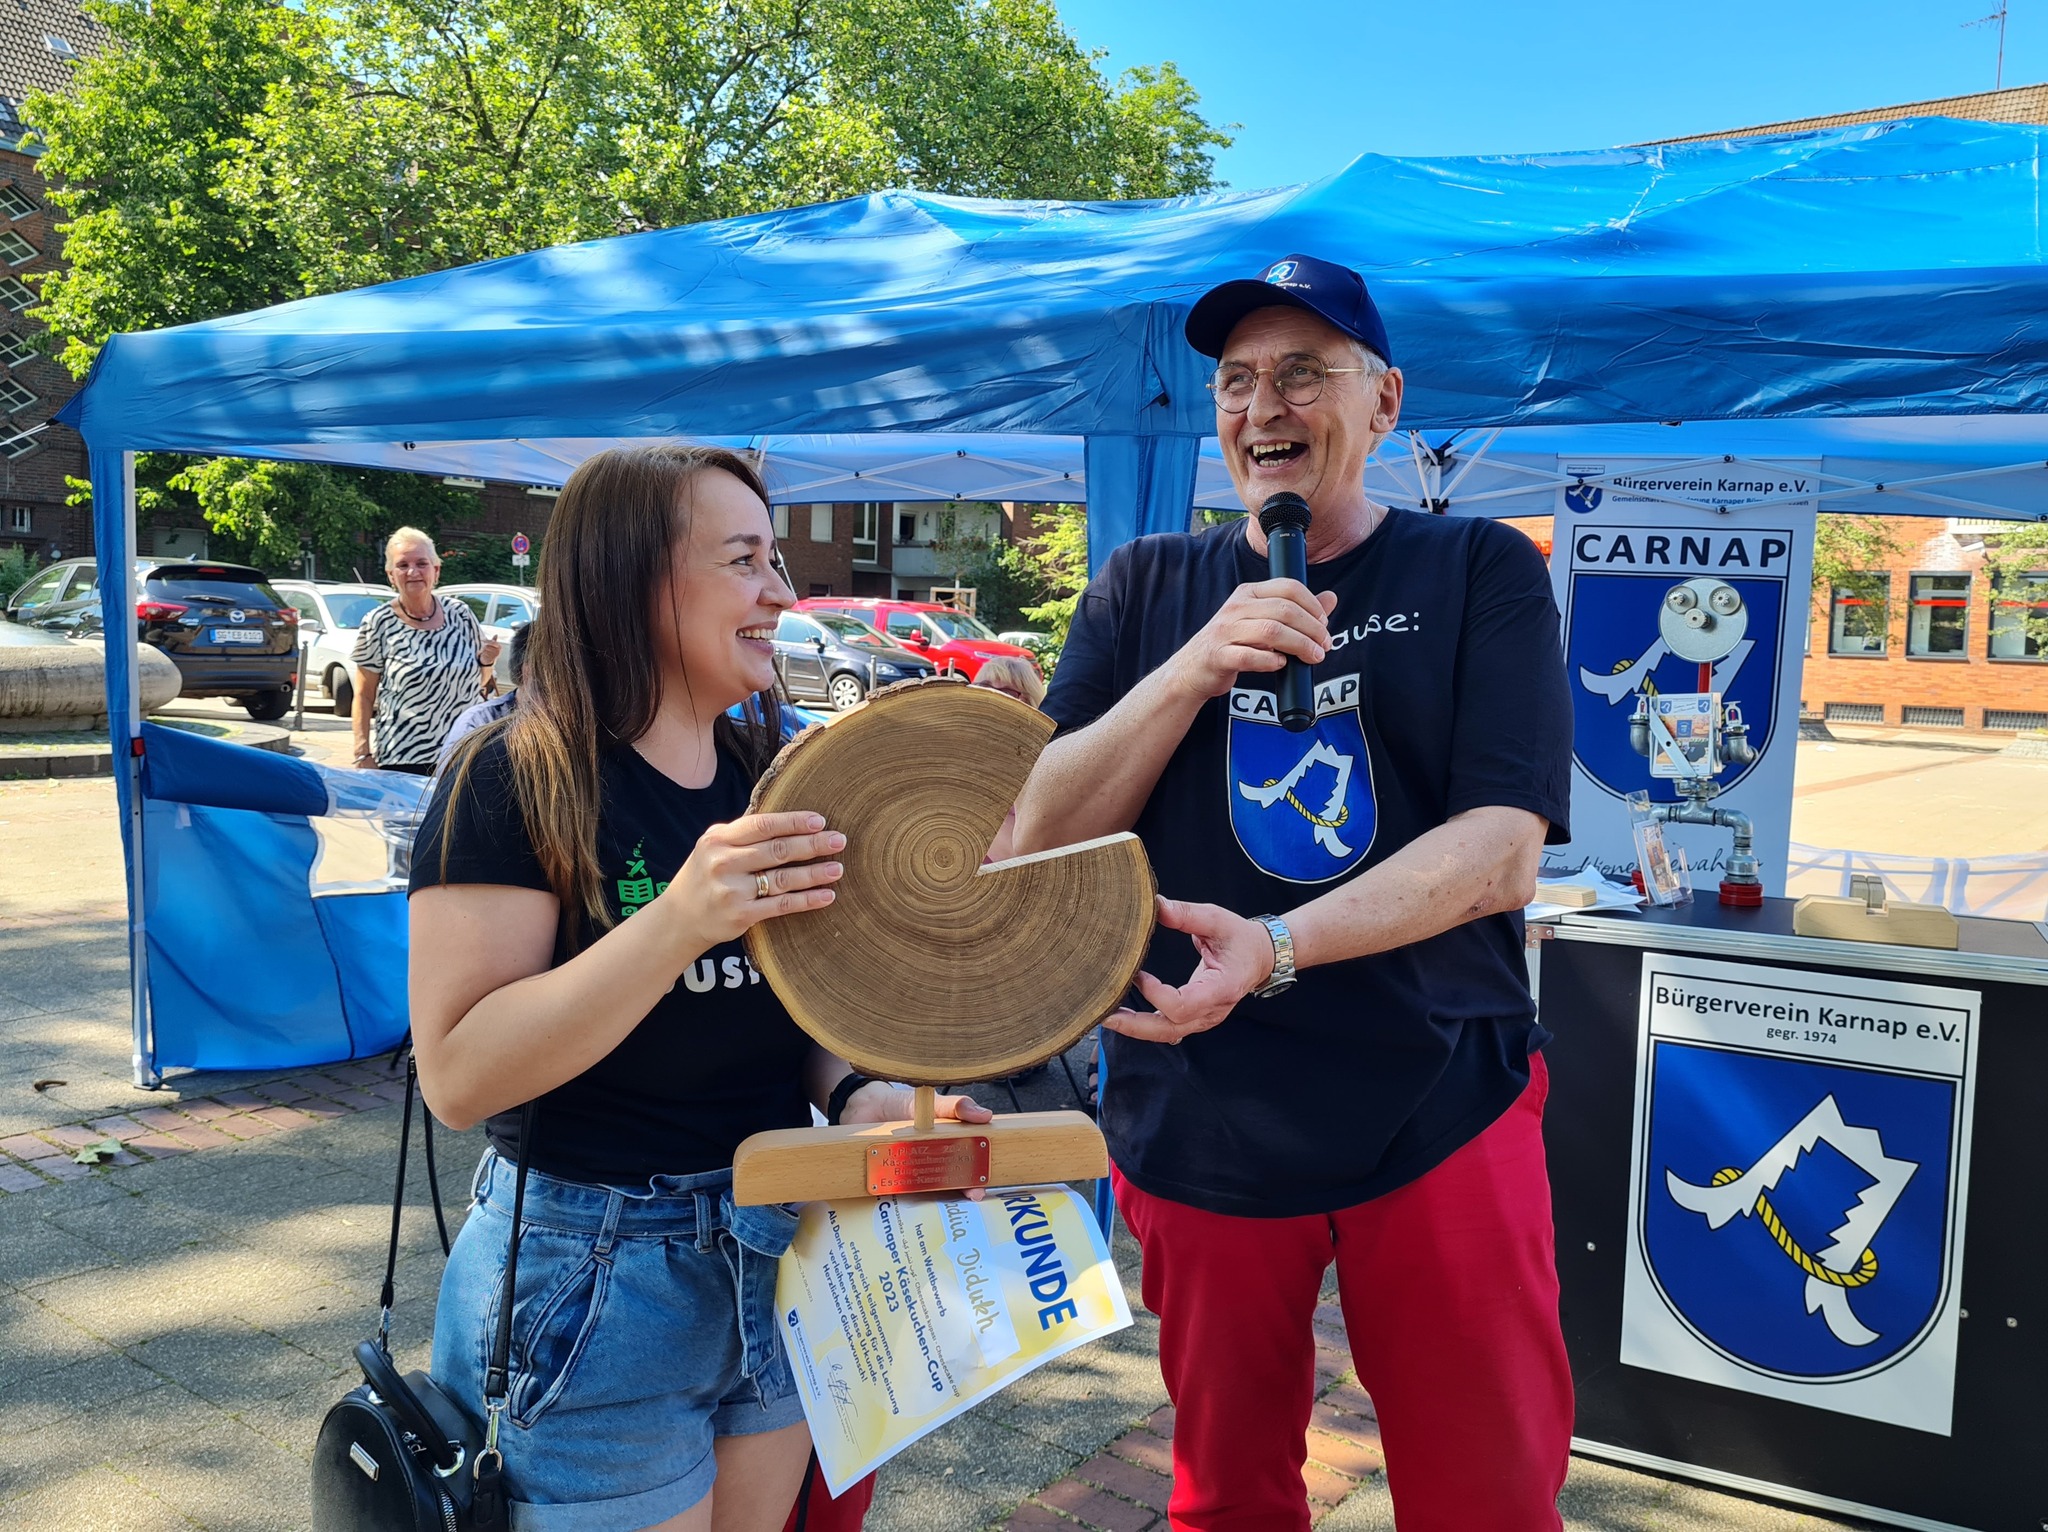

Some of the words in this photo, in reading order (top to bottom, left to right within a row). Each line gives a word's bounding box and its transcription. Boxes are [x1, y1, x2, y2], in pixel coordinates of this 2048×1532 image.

[1718, 478, 1774, 494] Karnap
[1778, 479, 1810, 493] e.V.
[1576, 534, 1787, 568] CARNAP
[1230, 679, 1357, 717] CAAP
[1656, 986, 1810, 1023] Bürgerverein
[1818, 1007, 1908, 1039] Karnap
[1916, 1021, 1961, 1043] e.V.
[1766, 1026, 1799, 1040] gegr.
[1804, 1030, 1837, 1045] 1974
[828, 1210, 837, 1224] Als
[915, 1223, 925, 1239] hat
[944, 1199, 967, 1242] adiia
[832, 1224, 845, 1250] Dank
[919, 1241, 927, 1256] am
[840, 1251, 852, 1270] und
[847, 1272, 872, 1337] Anerkennung
[850, 1241, 870, 1292] erfolgreich
[866, 1293, 893, 1366] teilgenommen.
[876, 1201, 902, 1264] Carnaper
[899, 1266, 944, 1392] Käsekuchen-Cup
[878, 1271, 899, 1312] 2023
[924, 1255, 947, 1317] Wettbewerb
[823, 1263, 842, 1314] Herzlichen
[841, 1314, 868, 1382] Glückwunsch!
[829, 1249, 846, 1293] verleihen
[844, 1294, 853, 1311] wir
[850, 1313, 862, 1338] diese
[860, 1338, 877, 1386] Urkunde.
[870, 1337, 878, 1351] für
[915, 1281, 929, 1319] Cheesecake
[936, 1345, 954, 1384] Cheesecake
[952, 1384, 960, 1398] cup
[876, 1354, 884, 1370] die
[882, 1370, 899, 1415] Leistung
